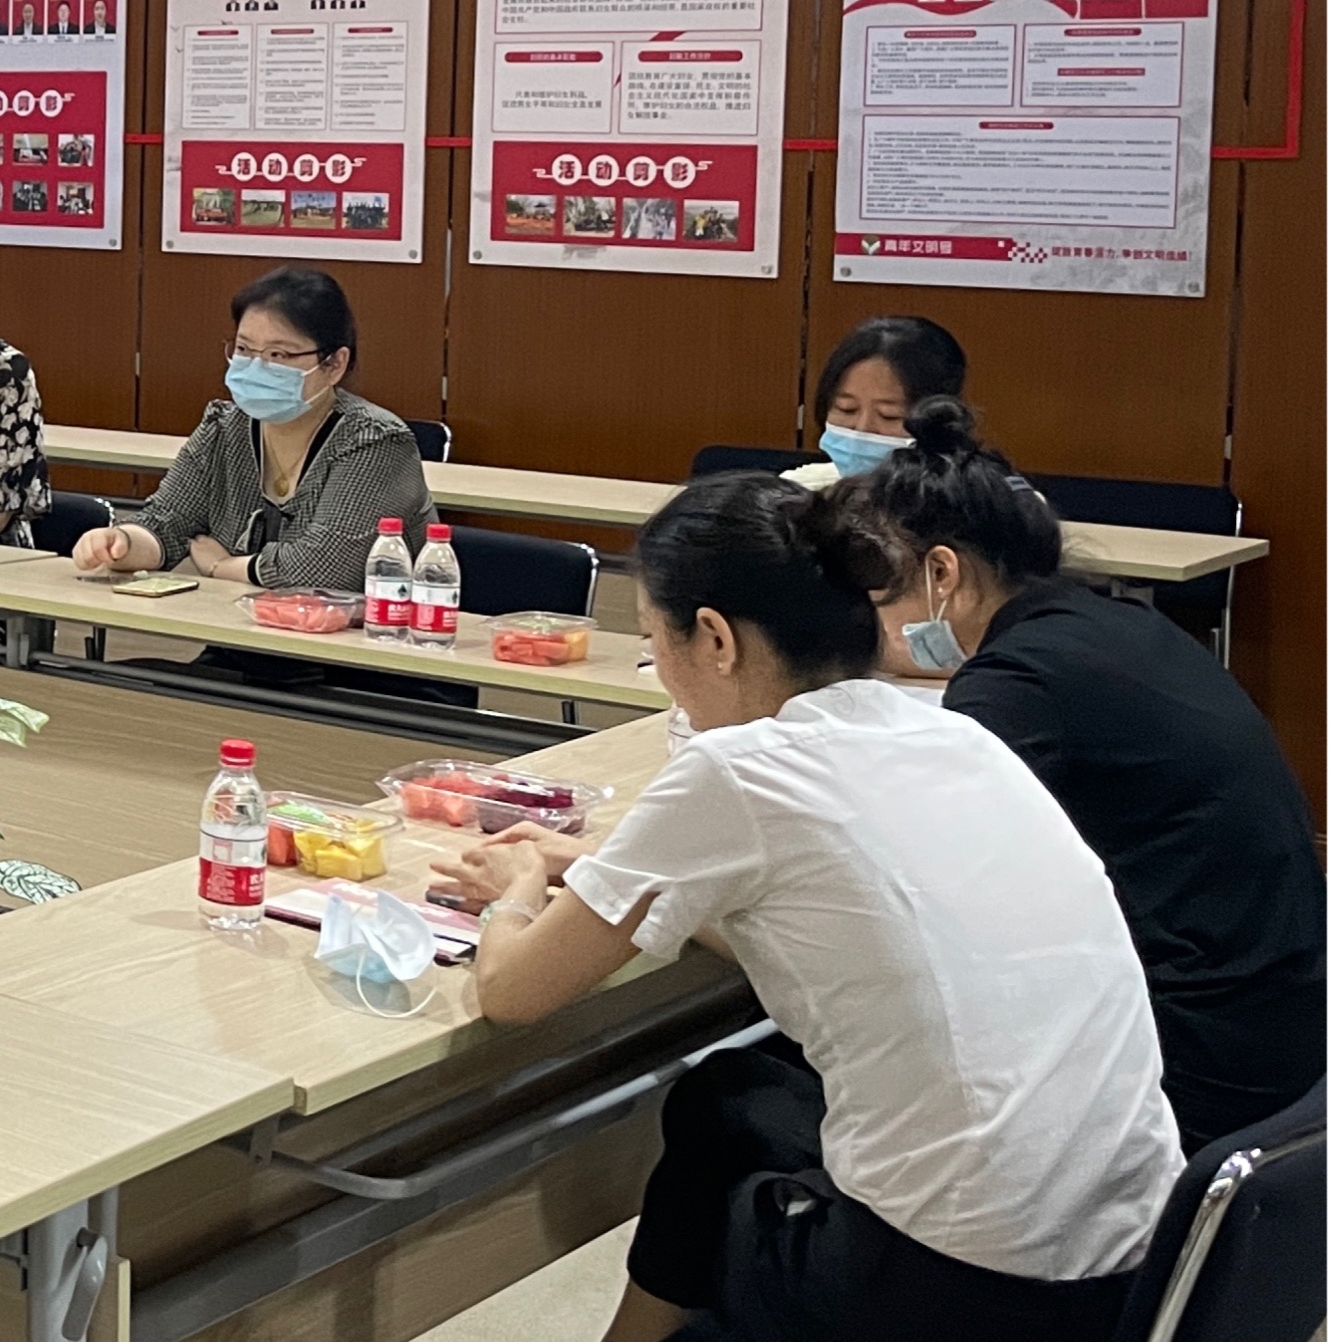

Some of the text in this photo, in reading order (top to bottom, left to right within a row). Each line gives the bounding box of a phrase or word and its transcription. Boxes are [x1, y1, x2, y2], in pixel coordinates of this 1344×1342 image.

[236, 155, 350, 180] 活动剪影
[558, 159, 689, 182] 活动剪影
[885, 240, 953, 255] 青年文明号
